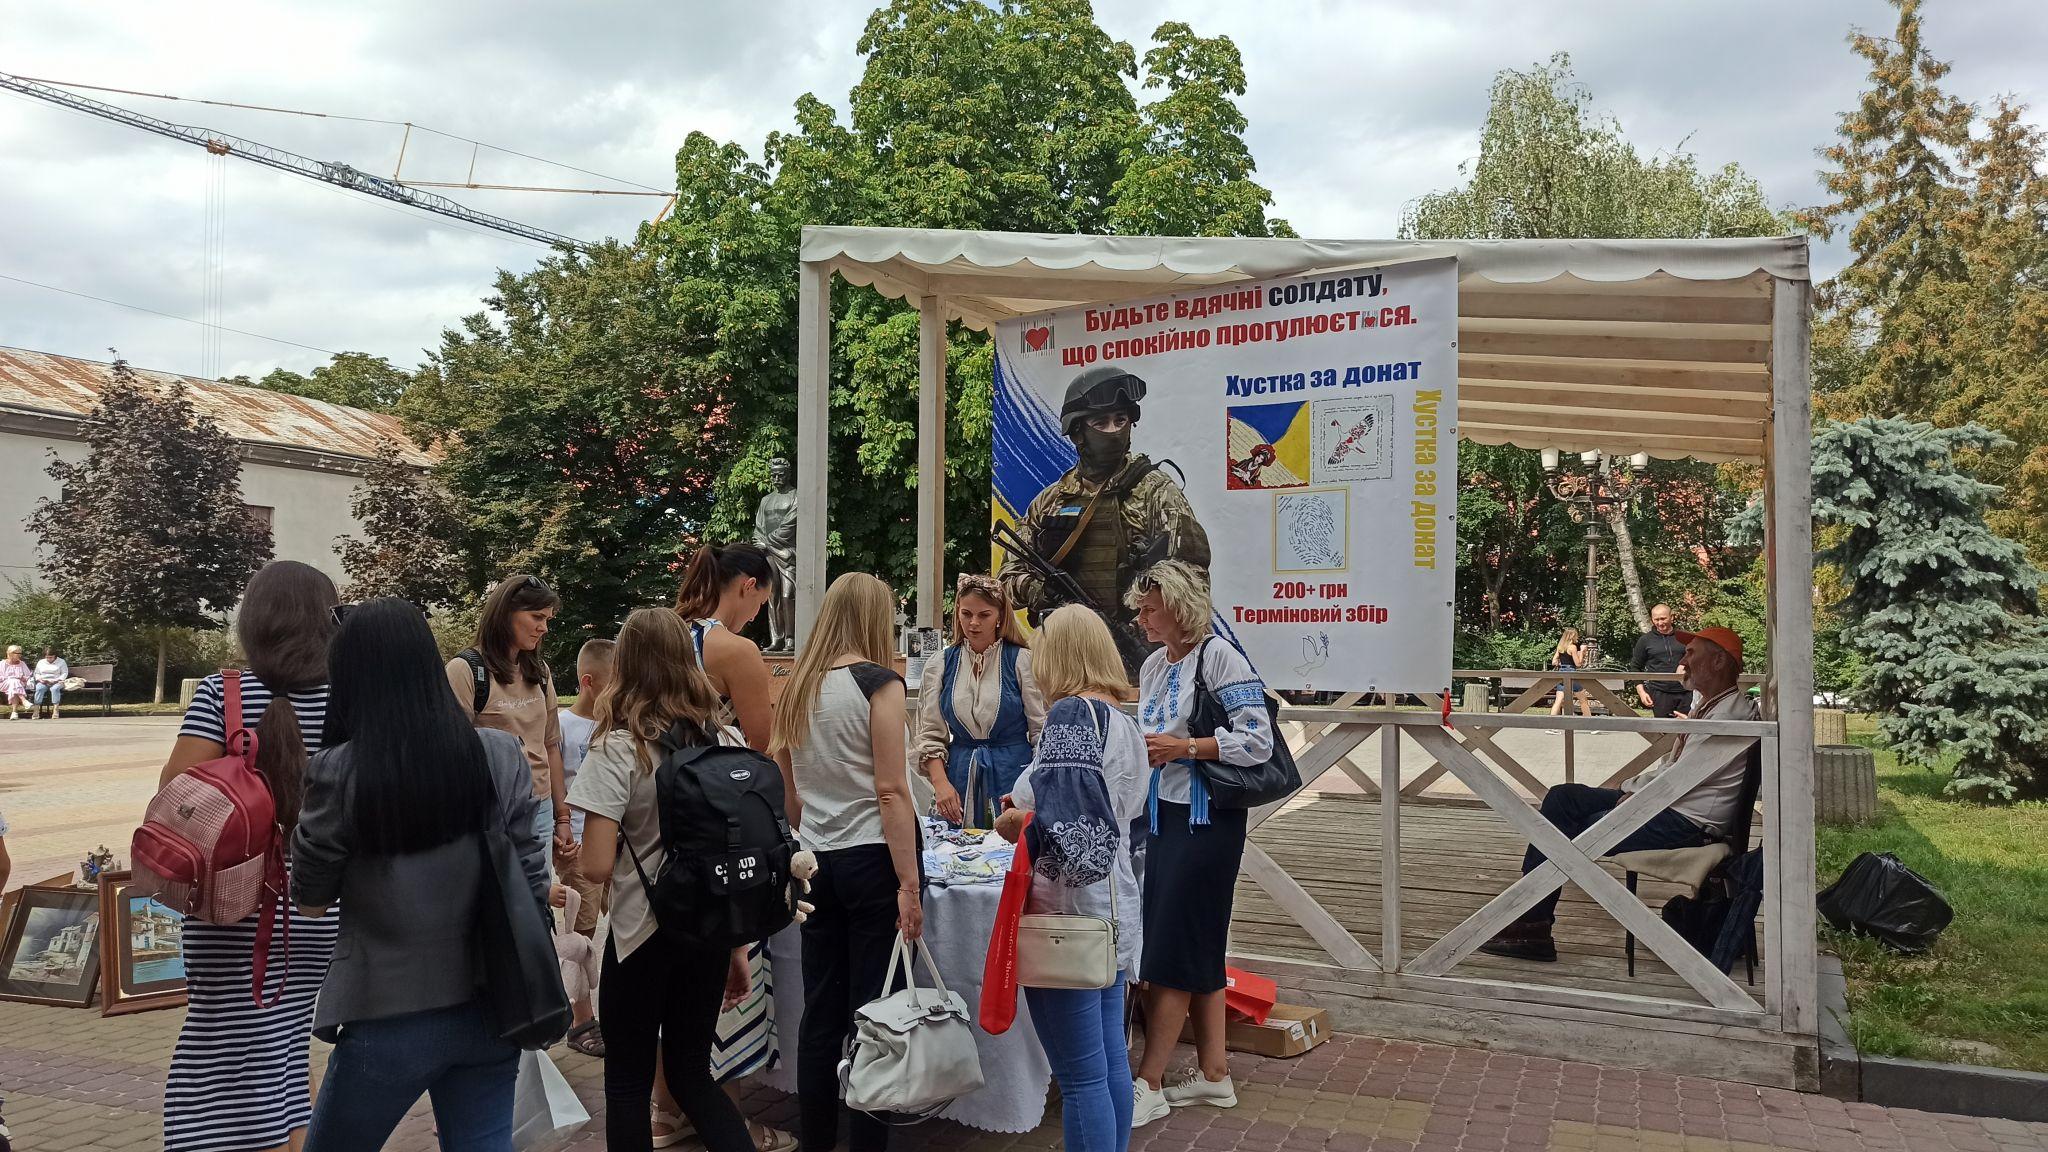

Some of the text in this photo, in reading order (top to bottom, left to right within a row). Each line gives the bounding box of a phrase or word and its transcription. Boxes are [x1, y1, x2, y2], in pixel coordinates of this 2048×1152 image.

[1085, 274, 1388, 332] Будьте вдячні солдату,
[1062, 344, 1097, 367] що
[1102, 327, 1210, 360] спокійно
[1225, 361, 1422, 397] Хустка за донат
[1411, 389, 1442, 569] Хустка за донат
[1272, 581, 1348, 599] 200+ грн
[1232, 604, 1388, 624] Терміновий збір
[1004, 960, 1012, 989] Shoes
